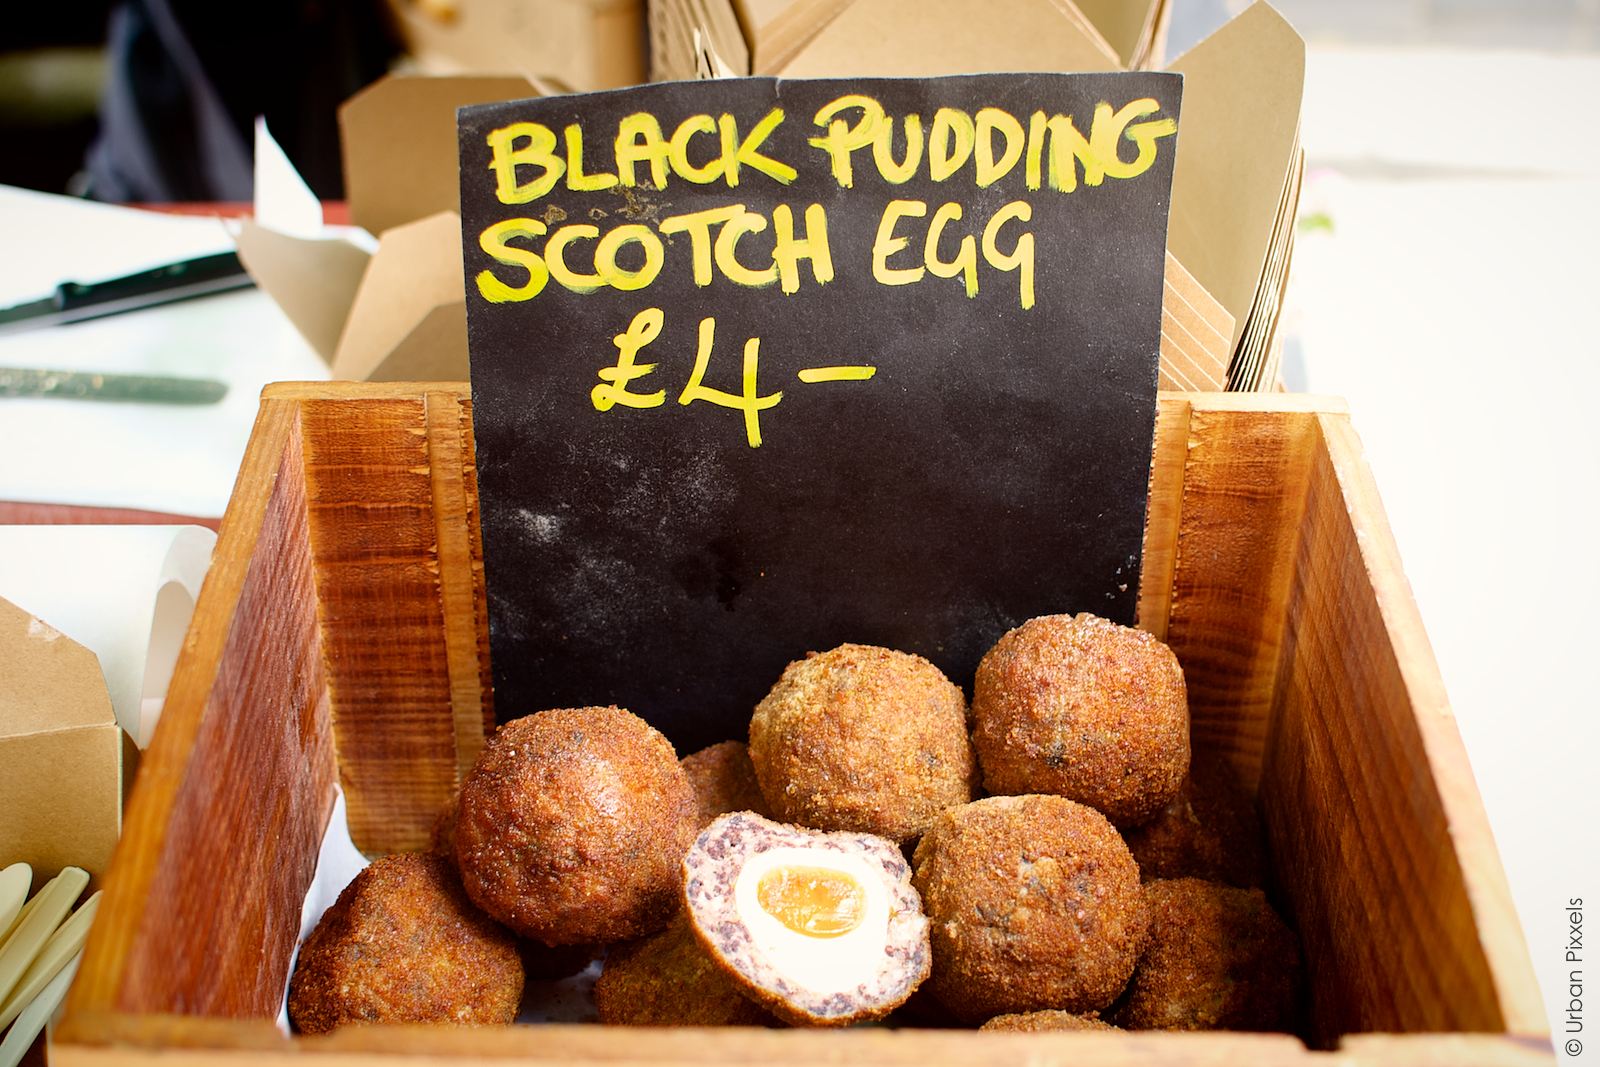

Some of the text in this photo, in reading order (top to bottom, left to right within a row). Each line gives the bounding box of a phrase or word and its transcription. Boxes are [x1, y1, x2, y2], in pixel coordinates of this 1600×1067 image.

[486, 94, 1179, 205] BLACK PUDDING
[475, 200, 1036, 311] SCOTCH EGG
